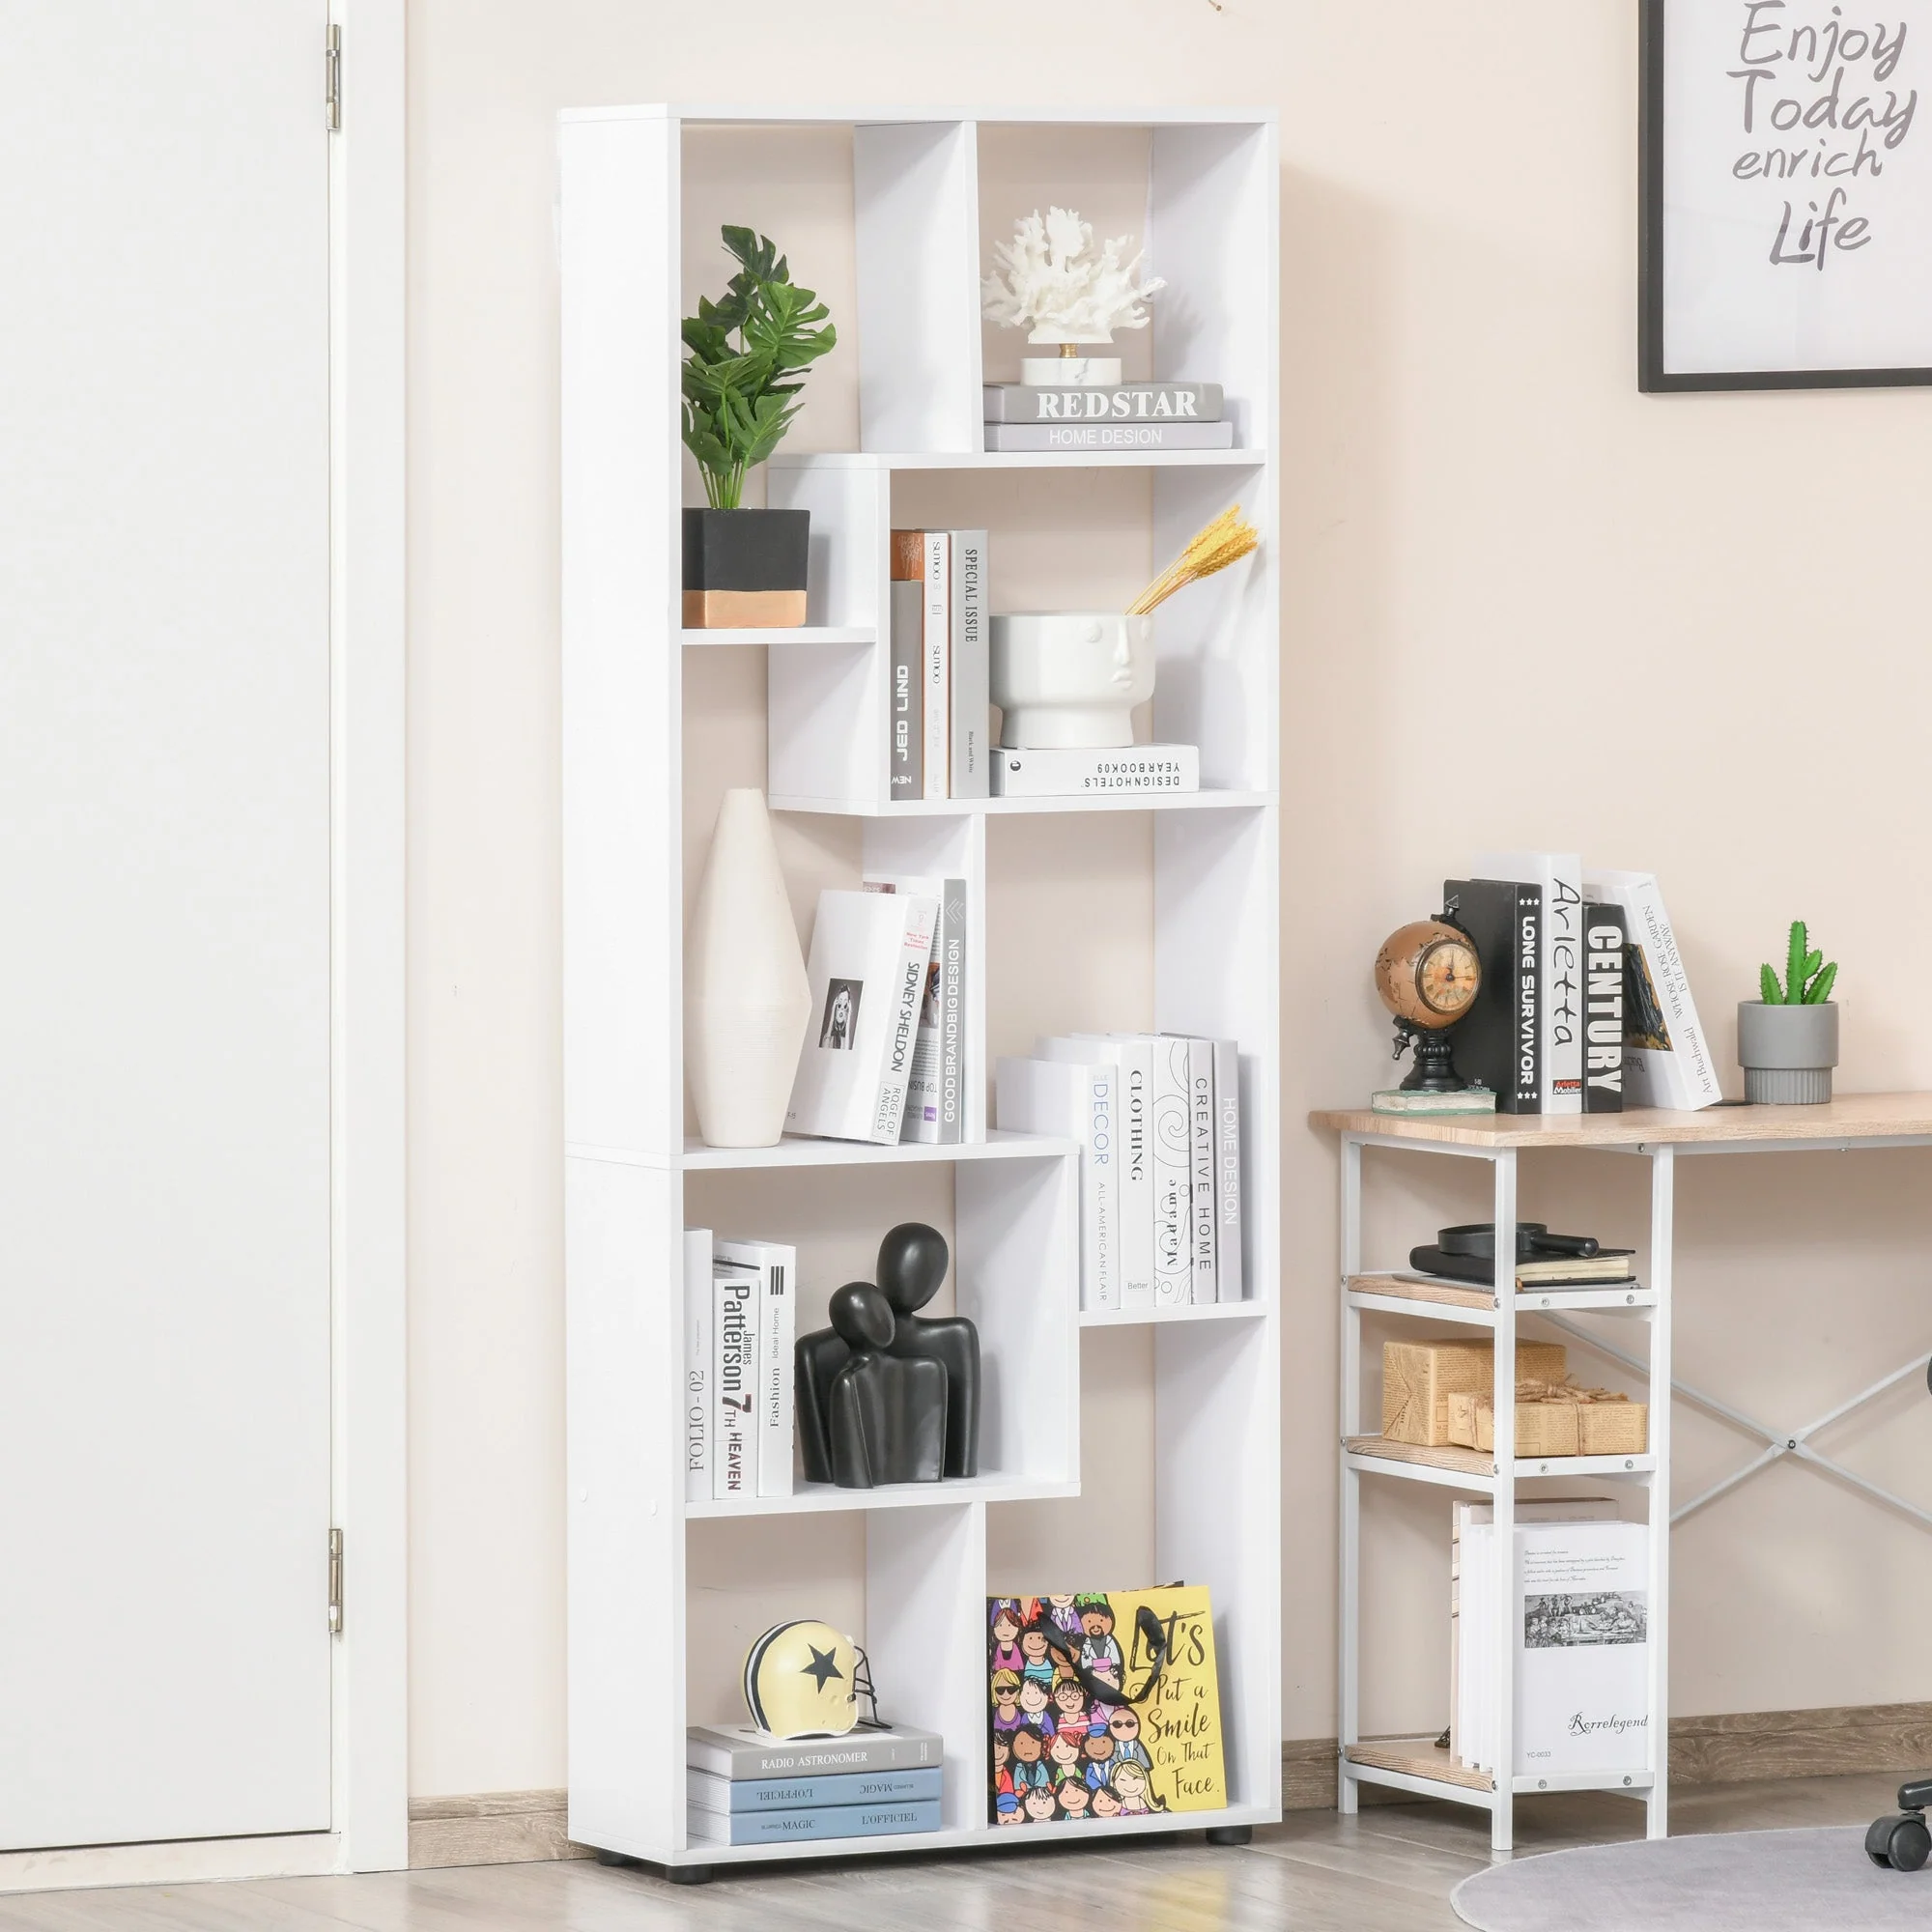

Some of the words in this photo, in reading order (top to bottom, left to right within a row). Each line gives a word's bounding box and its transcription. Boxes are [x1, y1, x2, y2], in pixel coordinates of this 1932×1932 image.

[1740, 0, 1907, 82] Enjoy
[1725, 66, 1918, 150] Today
[1732, 128, 1883, 180] enrich
[1770, 186, 1872, 271] Life
[1049, 430, 1097, 444] HOME
[1101, 429, 1162, 444] DESIGN
[965, 549, 978, 602] SPECIAL
[965, 607, 978, 642] ISSUE
[896, 665, 908, 712] LIND
[896, 720, 908, 762] JED
[947, 939, 960, 995] DESIGN
[1521, 916, 1536, 969] LONE
[1551, 877, 1581, 1046] Arletta
[1657, 952, 1672, 980] ROSE
[901, 962, 921, 1009] SIDNEY
[1586, 925, 1623, 1093] CENTURY
[891, 1009, 911, 1072] SHELDON
[1520, 975, 1536, 1085] SURVIVOR
[1684, 1026, 1708, 1077] Buchwald
[877, 1088, 891, 1130] ANGELS
[945, 1077, 955, 1122] GOOD
[1094, 1084, 1109, 1165] DECOR
[1130, 1070, 1143, 1180] CLOTHING
[1223, 1097, 1236, 1151] HOME
[887, 1121, 895, 1136] OF
[1195, 1078, 1209, 1192] CREATIVE
[1224, 1156, 1237, 1225] DESIGN
[1167, 1179, 1178, 1266] Madame
[1199, 1208, 1211, 1270] HOME
[1127, 1282, 1149, 1291] Better
[723, 1286, 751, 1391] Patterson
[742, 1330, 755, 1365] James
[689, 1370, 704, 1392] 02
[770, 1368, 781, 1427] Fashion
[689, 1406, 704, 1472] FOLIO
[727, 1432, 742, 1491] HEAVEN
[1155, 1674, 1192, 1705] Put
[1194, 1686, 1208, 1698] a
[1148, 1702, 1211, 1744] Smile
[761, 1757, 794, 1770] RADIO
[798, 1751, 867, 1767] ASTRONOMER
[1157, 1747, 1176, 1765] On
[1181, 1742, 1215, 1762] That
[756, 1788, 813, 1801] L'OFFICIEL
[859, 1783, 894, 1795] MAGIC
[782, 1819, 815, 1831] MAGIC
[862, 1812, 917, 1825] L'OFFICIEL
